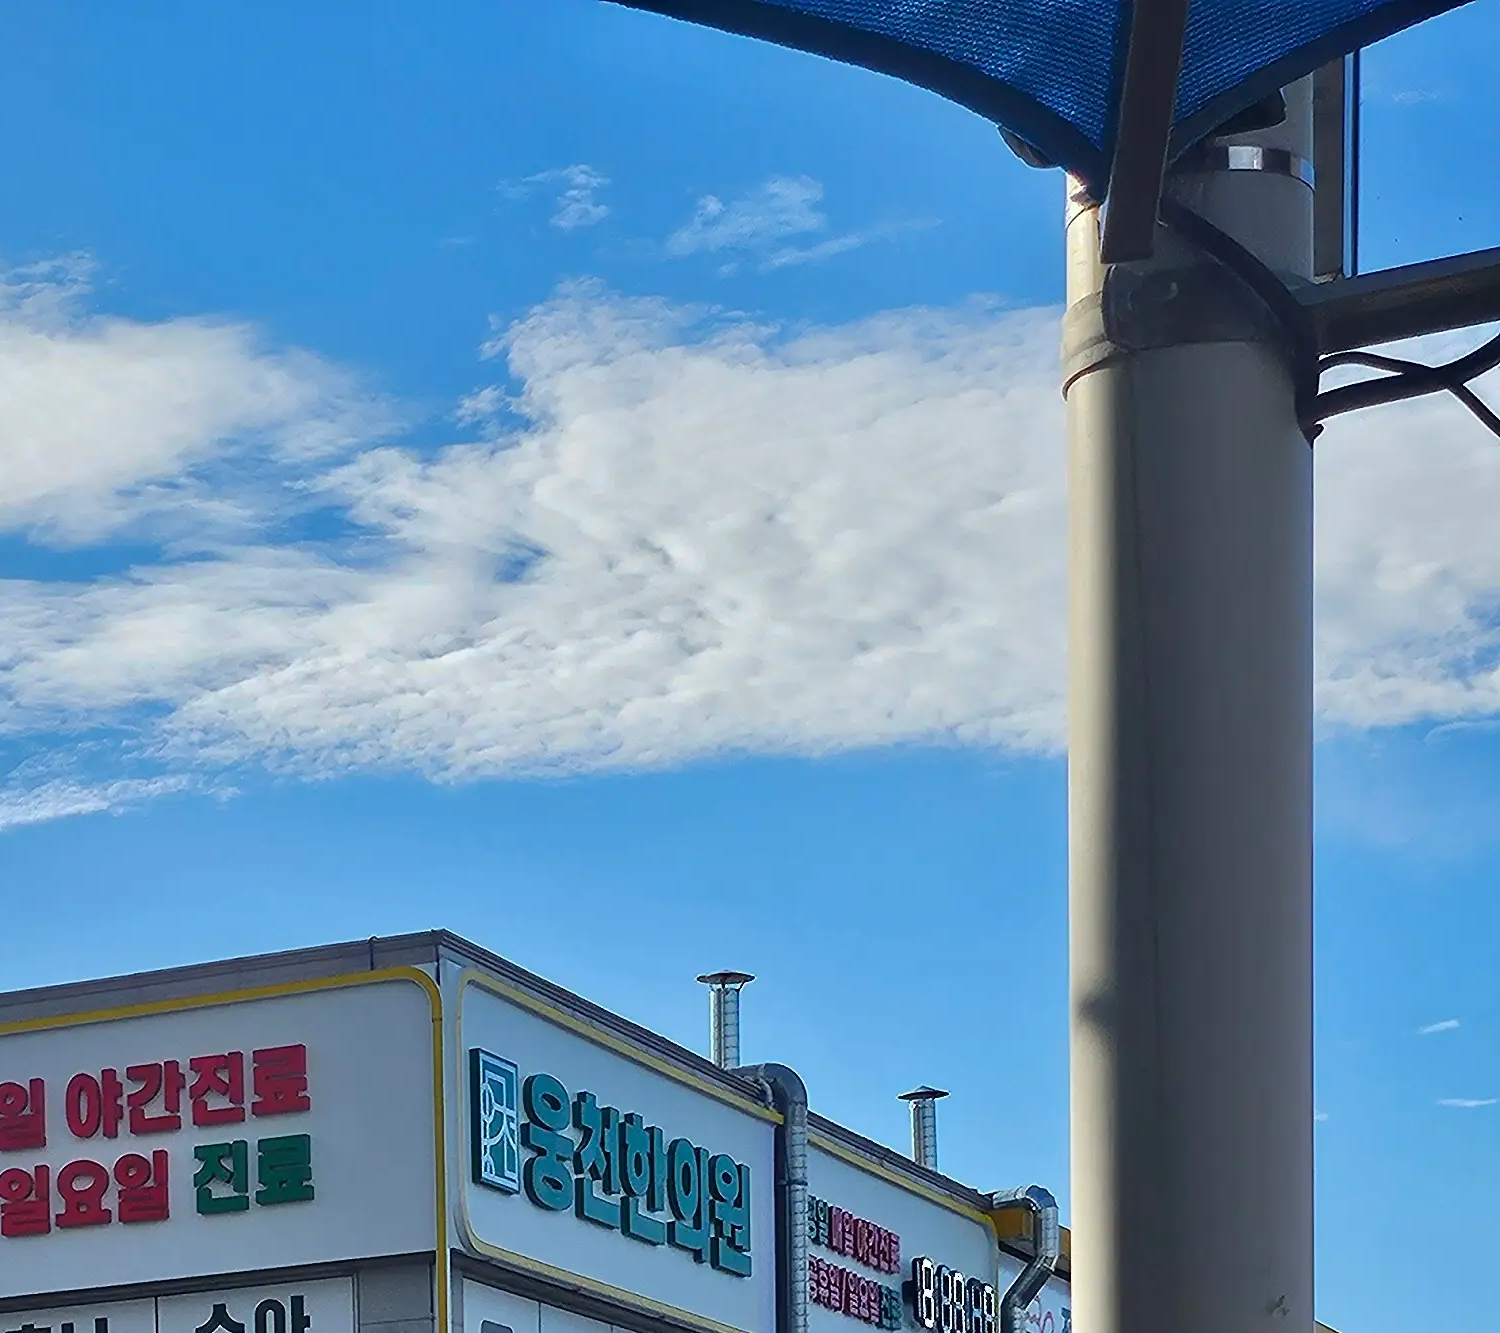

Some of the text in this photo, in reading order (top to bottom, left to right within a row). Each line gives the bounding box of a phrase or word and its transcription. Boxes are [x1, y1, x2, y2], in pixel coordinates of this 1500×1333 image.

[65, 1043, 311, 1140] 야간진료
[193, 1133, 315, 1215] 진료
[521, 1073, 753, 1278] 웅천한의원
